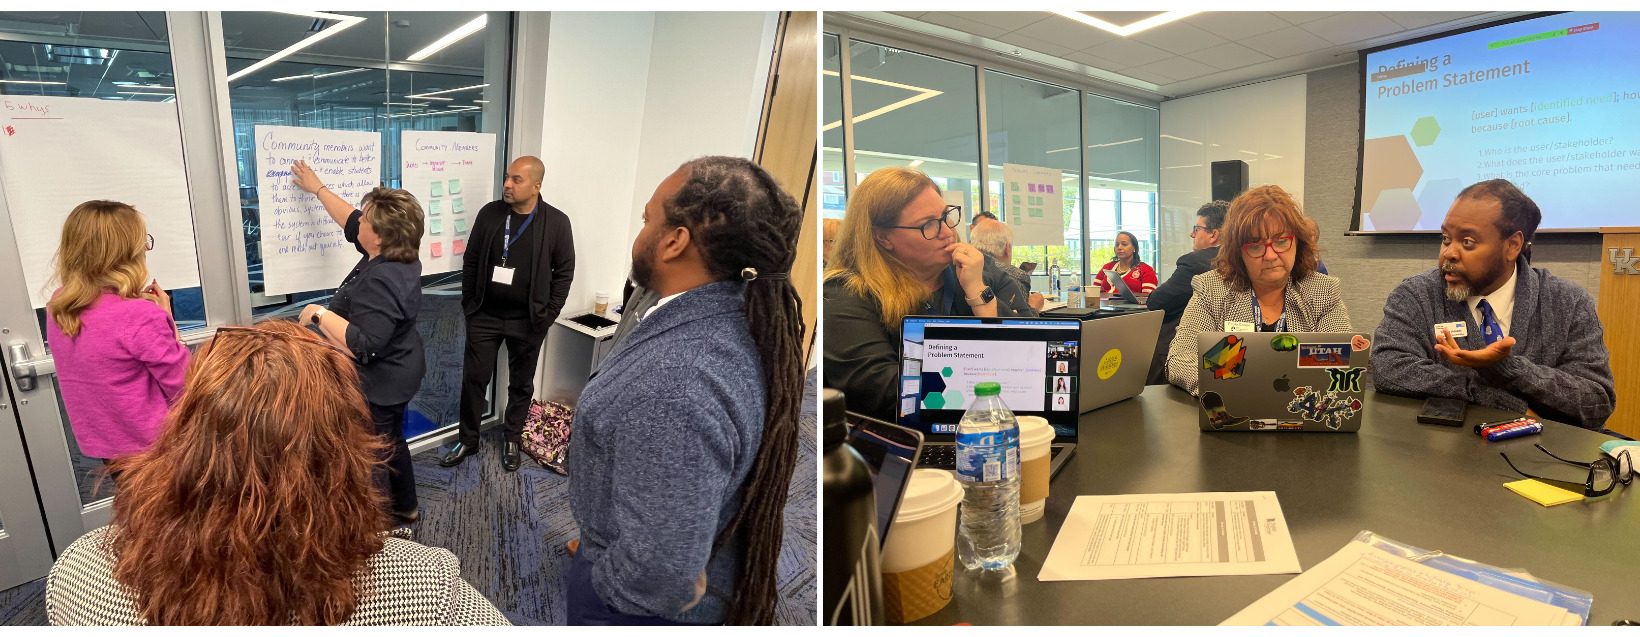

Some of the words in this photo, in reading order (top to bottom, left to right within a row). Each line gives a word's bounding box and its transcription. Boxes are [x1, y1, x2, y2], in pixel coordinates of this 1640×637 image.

[1378, 56, 1438, 72] Defining
[1442, 54, 1451, 66] a
[1378, 79, 1438, 99] Problem
[1443, 60, 1530, 87] Statement
[4, 100, 14, 111] 5
[1471, 108, 1498, 121] [user]
[1500, 104, 1528, 116] wants
[1530, 98, 1583, 112] [identified
[1586, 92, 1620, 105] need];
[1471, 122, 1509, 133] because
[1510, 118, 1534, 129] [root
[1537, 112, 1572, 125] cause].
[262, 131, 320, 157] Community
[323, 144, 354, 152] members
[358, 142, 375, 152] want
[1514, 144, 1528, 153] the
[1530, 136, 1614, 152] user/stakeholder?
[266, 152, 275, 165] to
[1506, 157, 1527, 166] does
[1529, 156, 1543, 164] the
[1546, 149, 1626, 163] user/stakeholder
[1506, 170, 1513, 178] is
[1515, 169, 1529, 177] the
[1531, 168, 1550, 177] core
[1553, 164, 1591, 177] problem
[1594, 163, 1614, 171] that
[270, 183, 278, 191] to
[272, 193, 288, 203] them
[273, 218, 285, 229] the
[289, 220, 310, 230] system
[304, 233, 314, 246] you
[279, 245, 289, 254] and
[1608, 248, 1640, 275] UK
